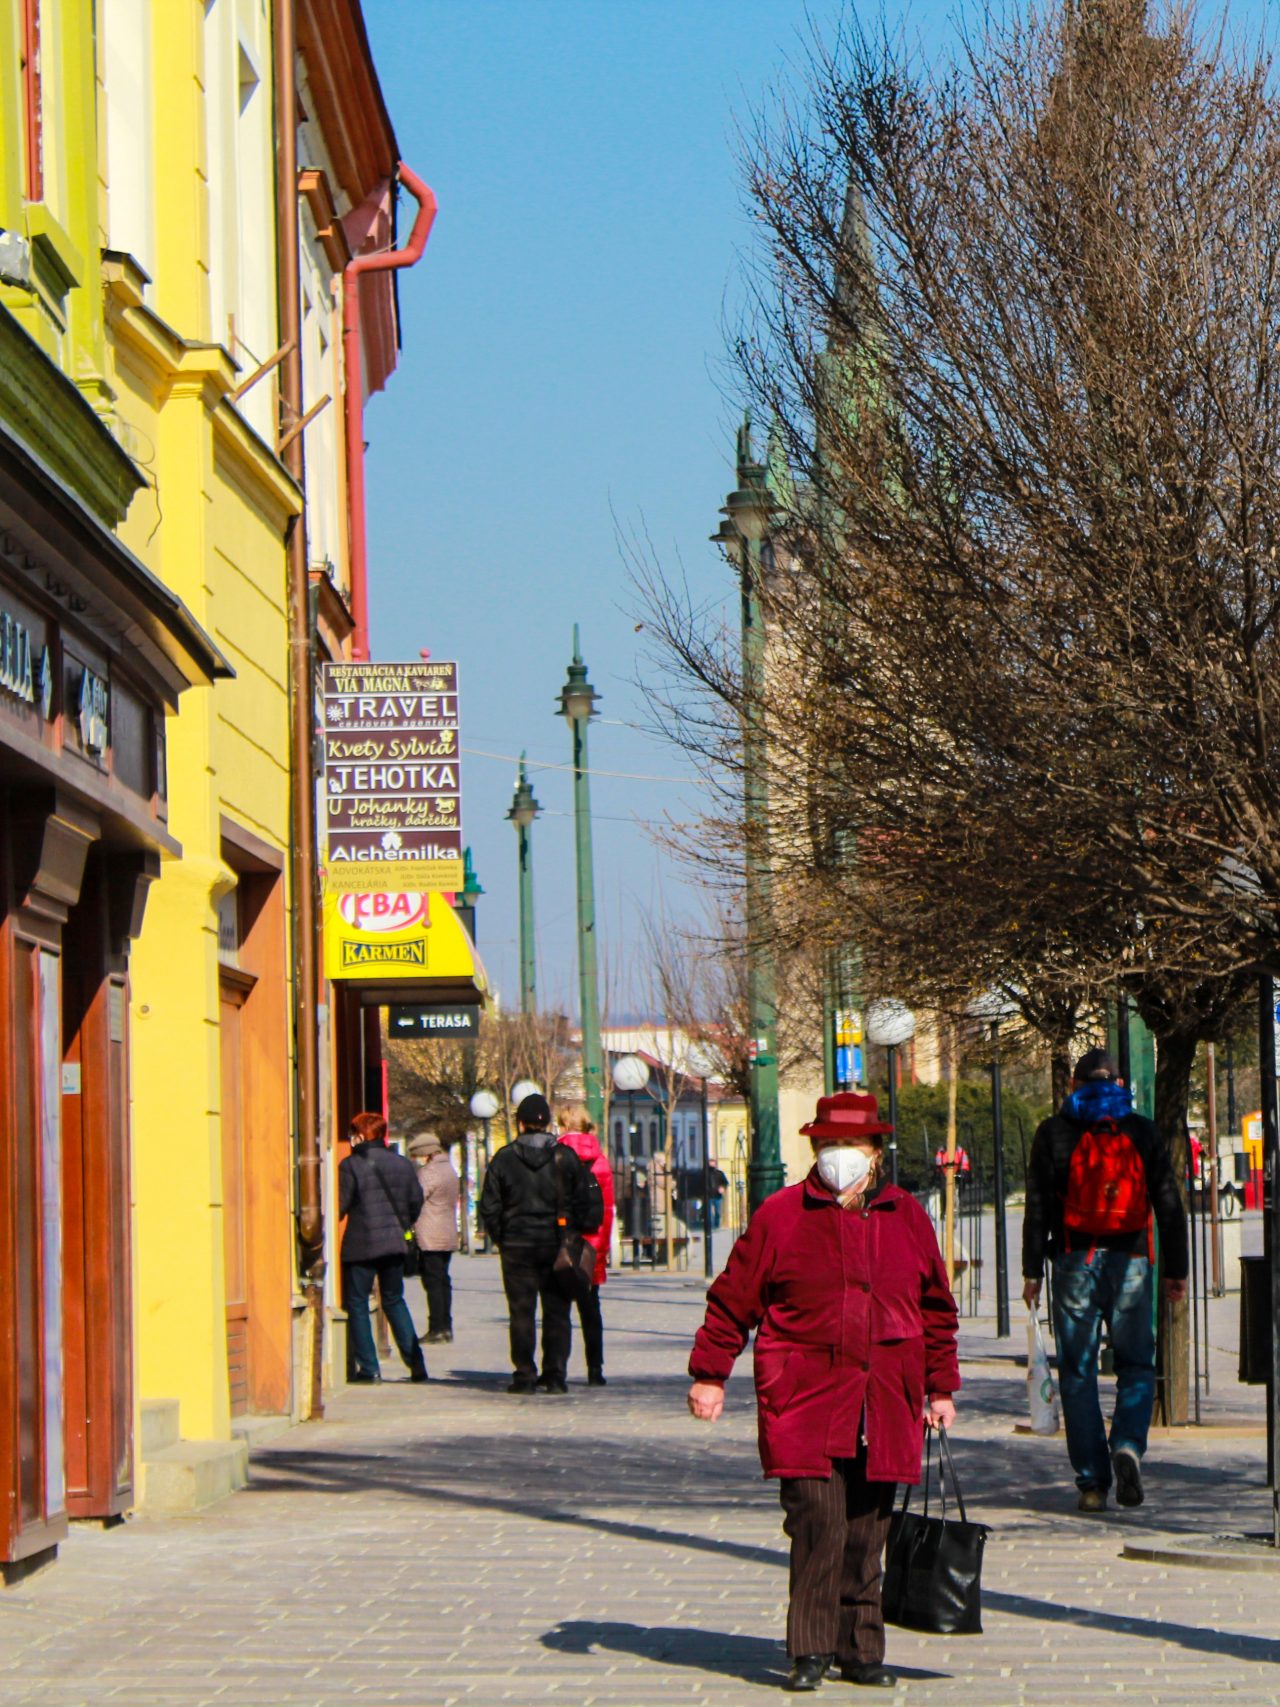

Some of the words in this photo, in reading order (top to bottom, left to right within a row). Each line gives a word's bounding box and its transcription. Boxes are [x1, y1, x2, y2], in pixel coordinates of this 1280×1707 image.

[0, 612, 34, 703] RIA
[397, 666, 404, 677] A
[404, 664, 452, 676] KAVIAREŇ
[338, 698, 457, 718] TRAVEL
[328, 739, 385, 760] Kvety
[336, 766, 456, 790] TEHOTKA
[329, 799, 342, 815] U
[348, 797, 429, 817] Johanky
[351, 815, 402, 828] hračky,
[405, 814, 458, 827] darčeky
[330, 845, 459, 861] Alchemilka
[355, 892, 411, 917] CBA
[344, 940, 424, 962] KARMEN
[420, 1015, 471, 1028] TERASA
